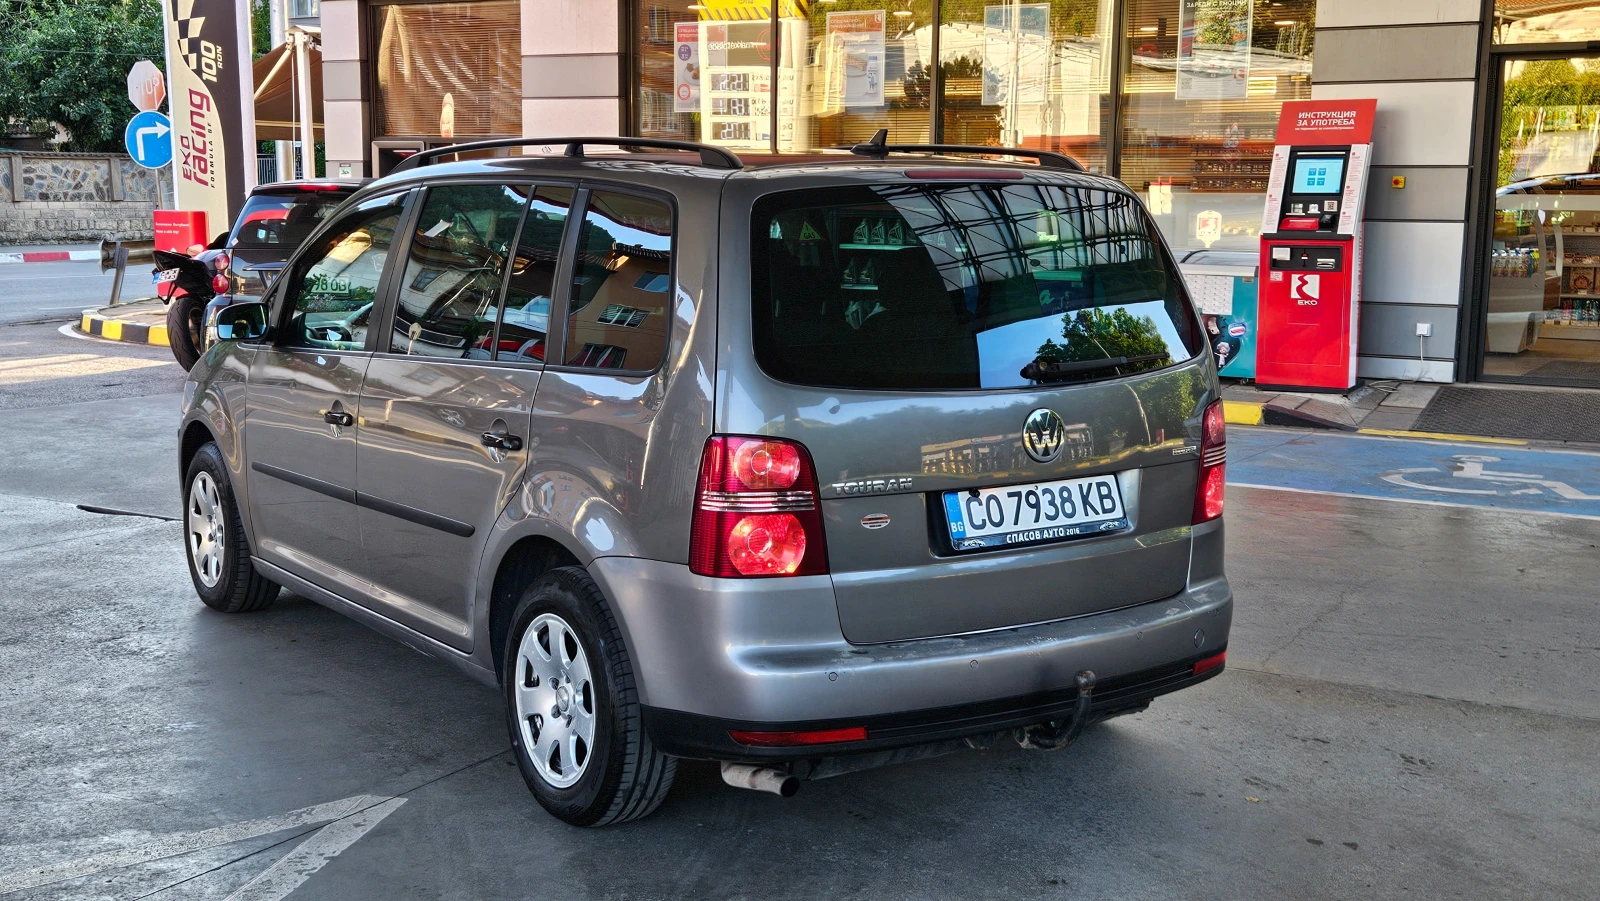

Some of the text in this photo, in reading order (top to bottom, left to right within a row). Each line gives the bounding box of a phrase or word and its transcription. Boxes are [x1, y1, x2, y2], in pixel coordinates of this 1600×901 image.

[200, 39, 218, 83] 100
[1296, 118, 1355, 127] ЗА УПОТРЕБА
[1298, 110, 1357, 120] ИНСТРУКЦИЯ
[188, 88, 211, 187] racing
[208, 140, 216, 189] FORMULA
[832, 477, 913, 496] TOURAN
[951, 521, 964, 533] BG
[1006, 527, 1080, 544] СПАСОВ АУТО 2016
